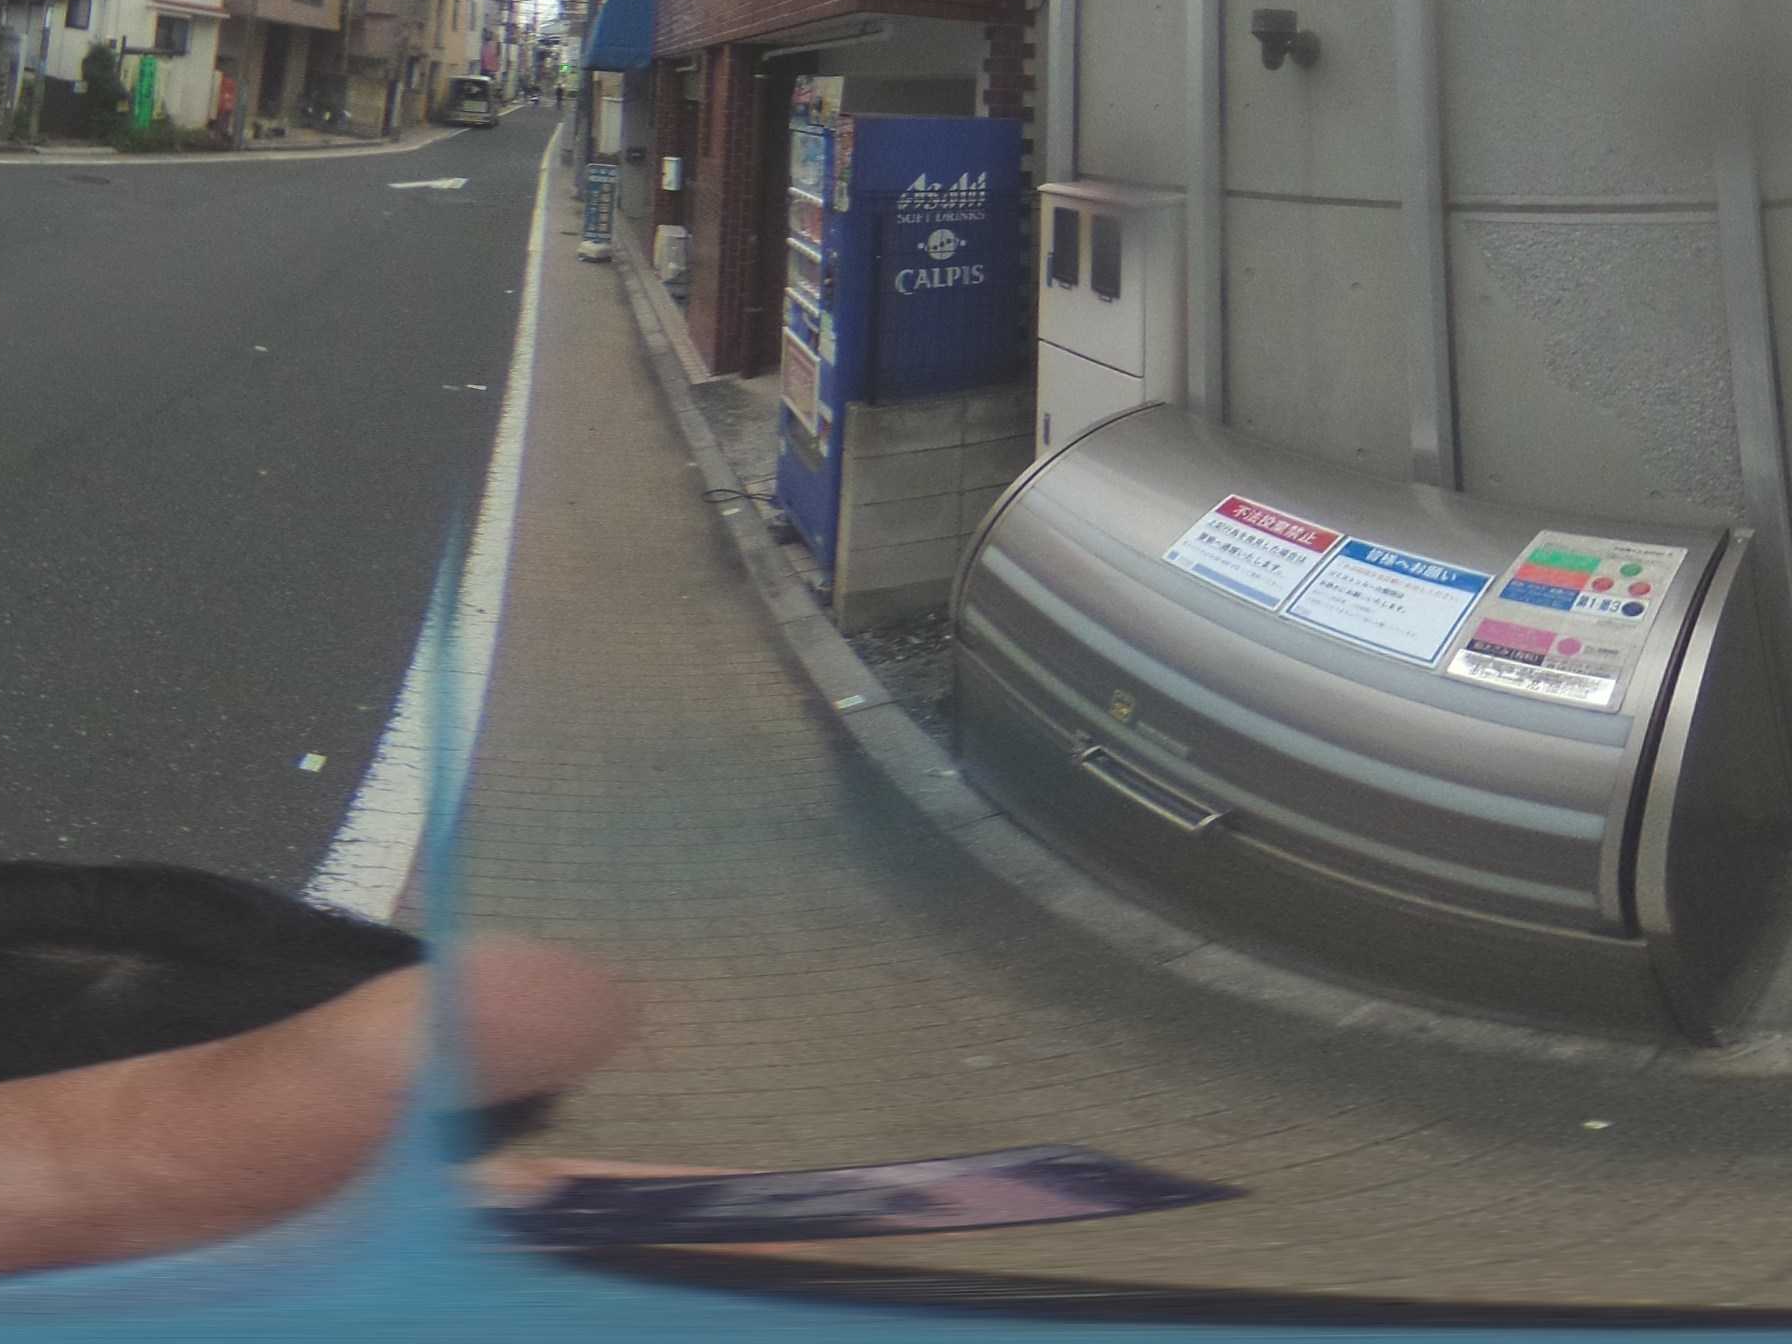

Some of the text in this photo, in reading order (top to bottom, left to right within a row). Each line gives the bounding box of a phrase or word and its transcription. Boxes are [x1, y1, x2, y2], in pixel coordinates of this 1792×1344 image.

[896, 170, 987, 210] Asahi
[894, 264, 985, 295] CALPIS
[1232, 503, 1318, 545] 不法投棄禁止
[1364, 547, 1457, 582] 皆様へお願い
